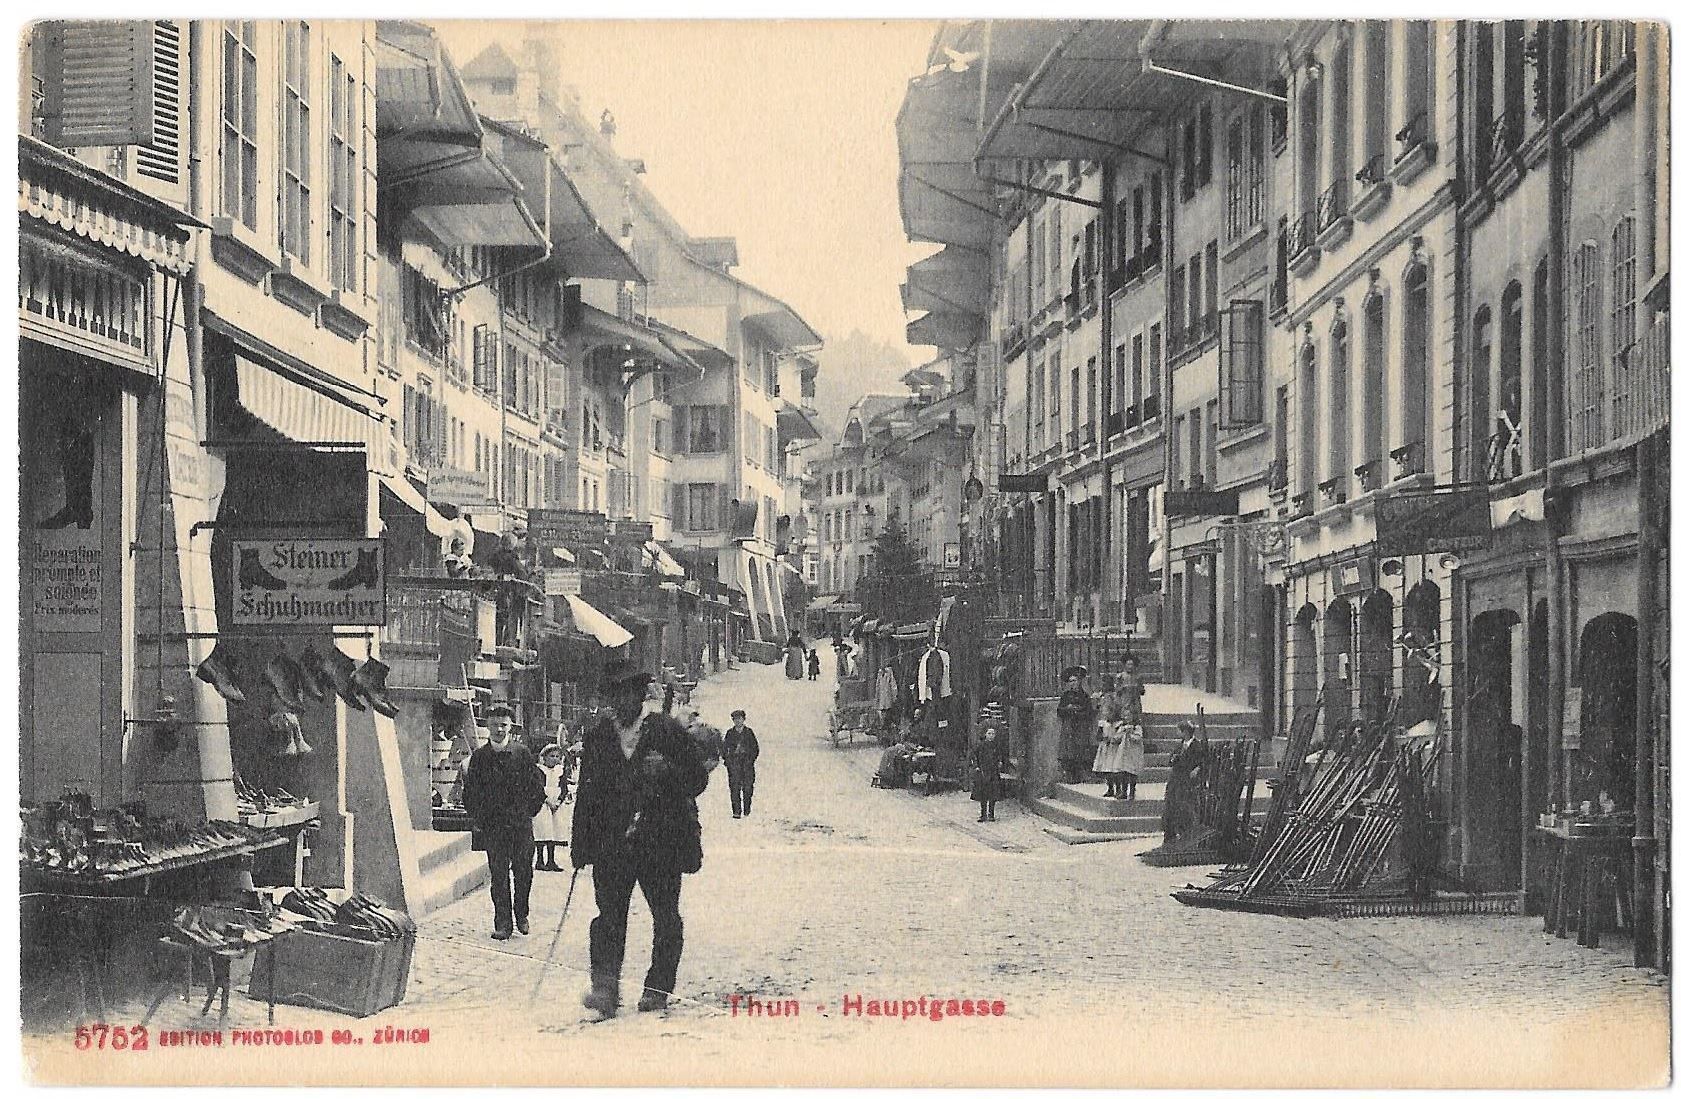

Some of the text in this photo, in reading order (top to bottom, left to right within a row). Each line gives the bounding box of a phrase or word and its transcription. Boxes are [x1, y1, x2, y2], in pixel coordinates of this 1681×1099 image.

[269, 542, 351, 569] Steiner
[33, 565, 101, 586] prompte et
[45, 582, 98, 605] soignée
[34, 601, 57, 615] Prix
[235, 592, 380, 621] Schuhmacher
